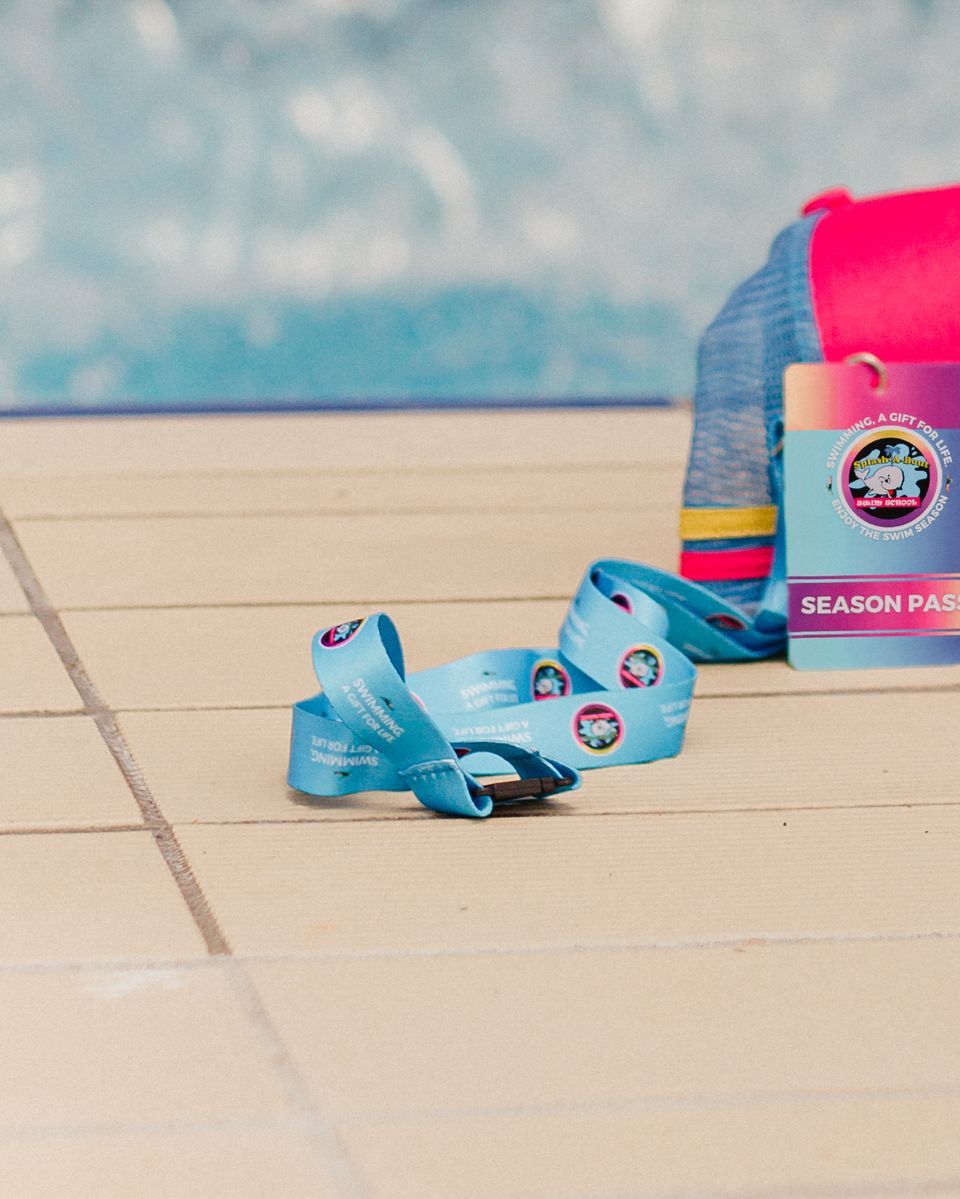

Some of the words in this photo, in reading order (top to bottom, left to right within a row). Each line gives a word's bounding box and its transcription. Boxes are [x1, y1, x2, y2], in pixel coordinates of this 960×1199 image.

[878, 413, 886, 422] A
[889, 412, 917, 425] GIFT
[916, 420, 939, 441] FOR
[831, 499, 859, 529] ENJOY
[859, 528, 881, 540] THE
[882, 529, 914, 541] SWIM
[915, 494, 948, 533] SEASON
[800, 595, 902, 615] SEASON
[347, 692, 367, 715] GIFT
[362, 713, 381, 731] FOR
[327, 740, 348, 752] FOR
